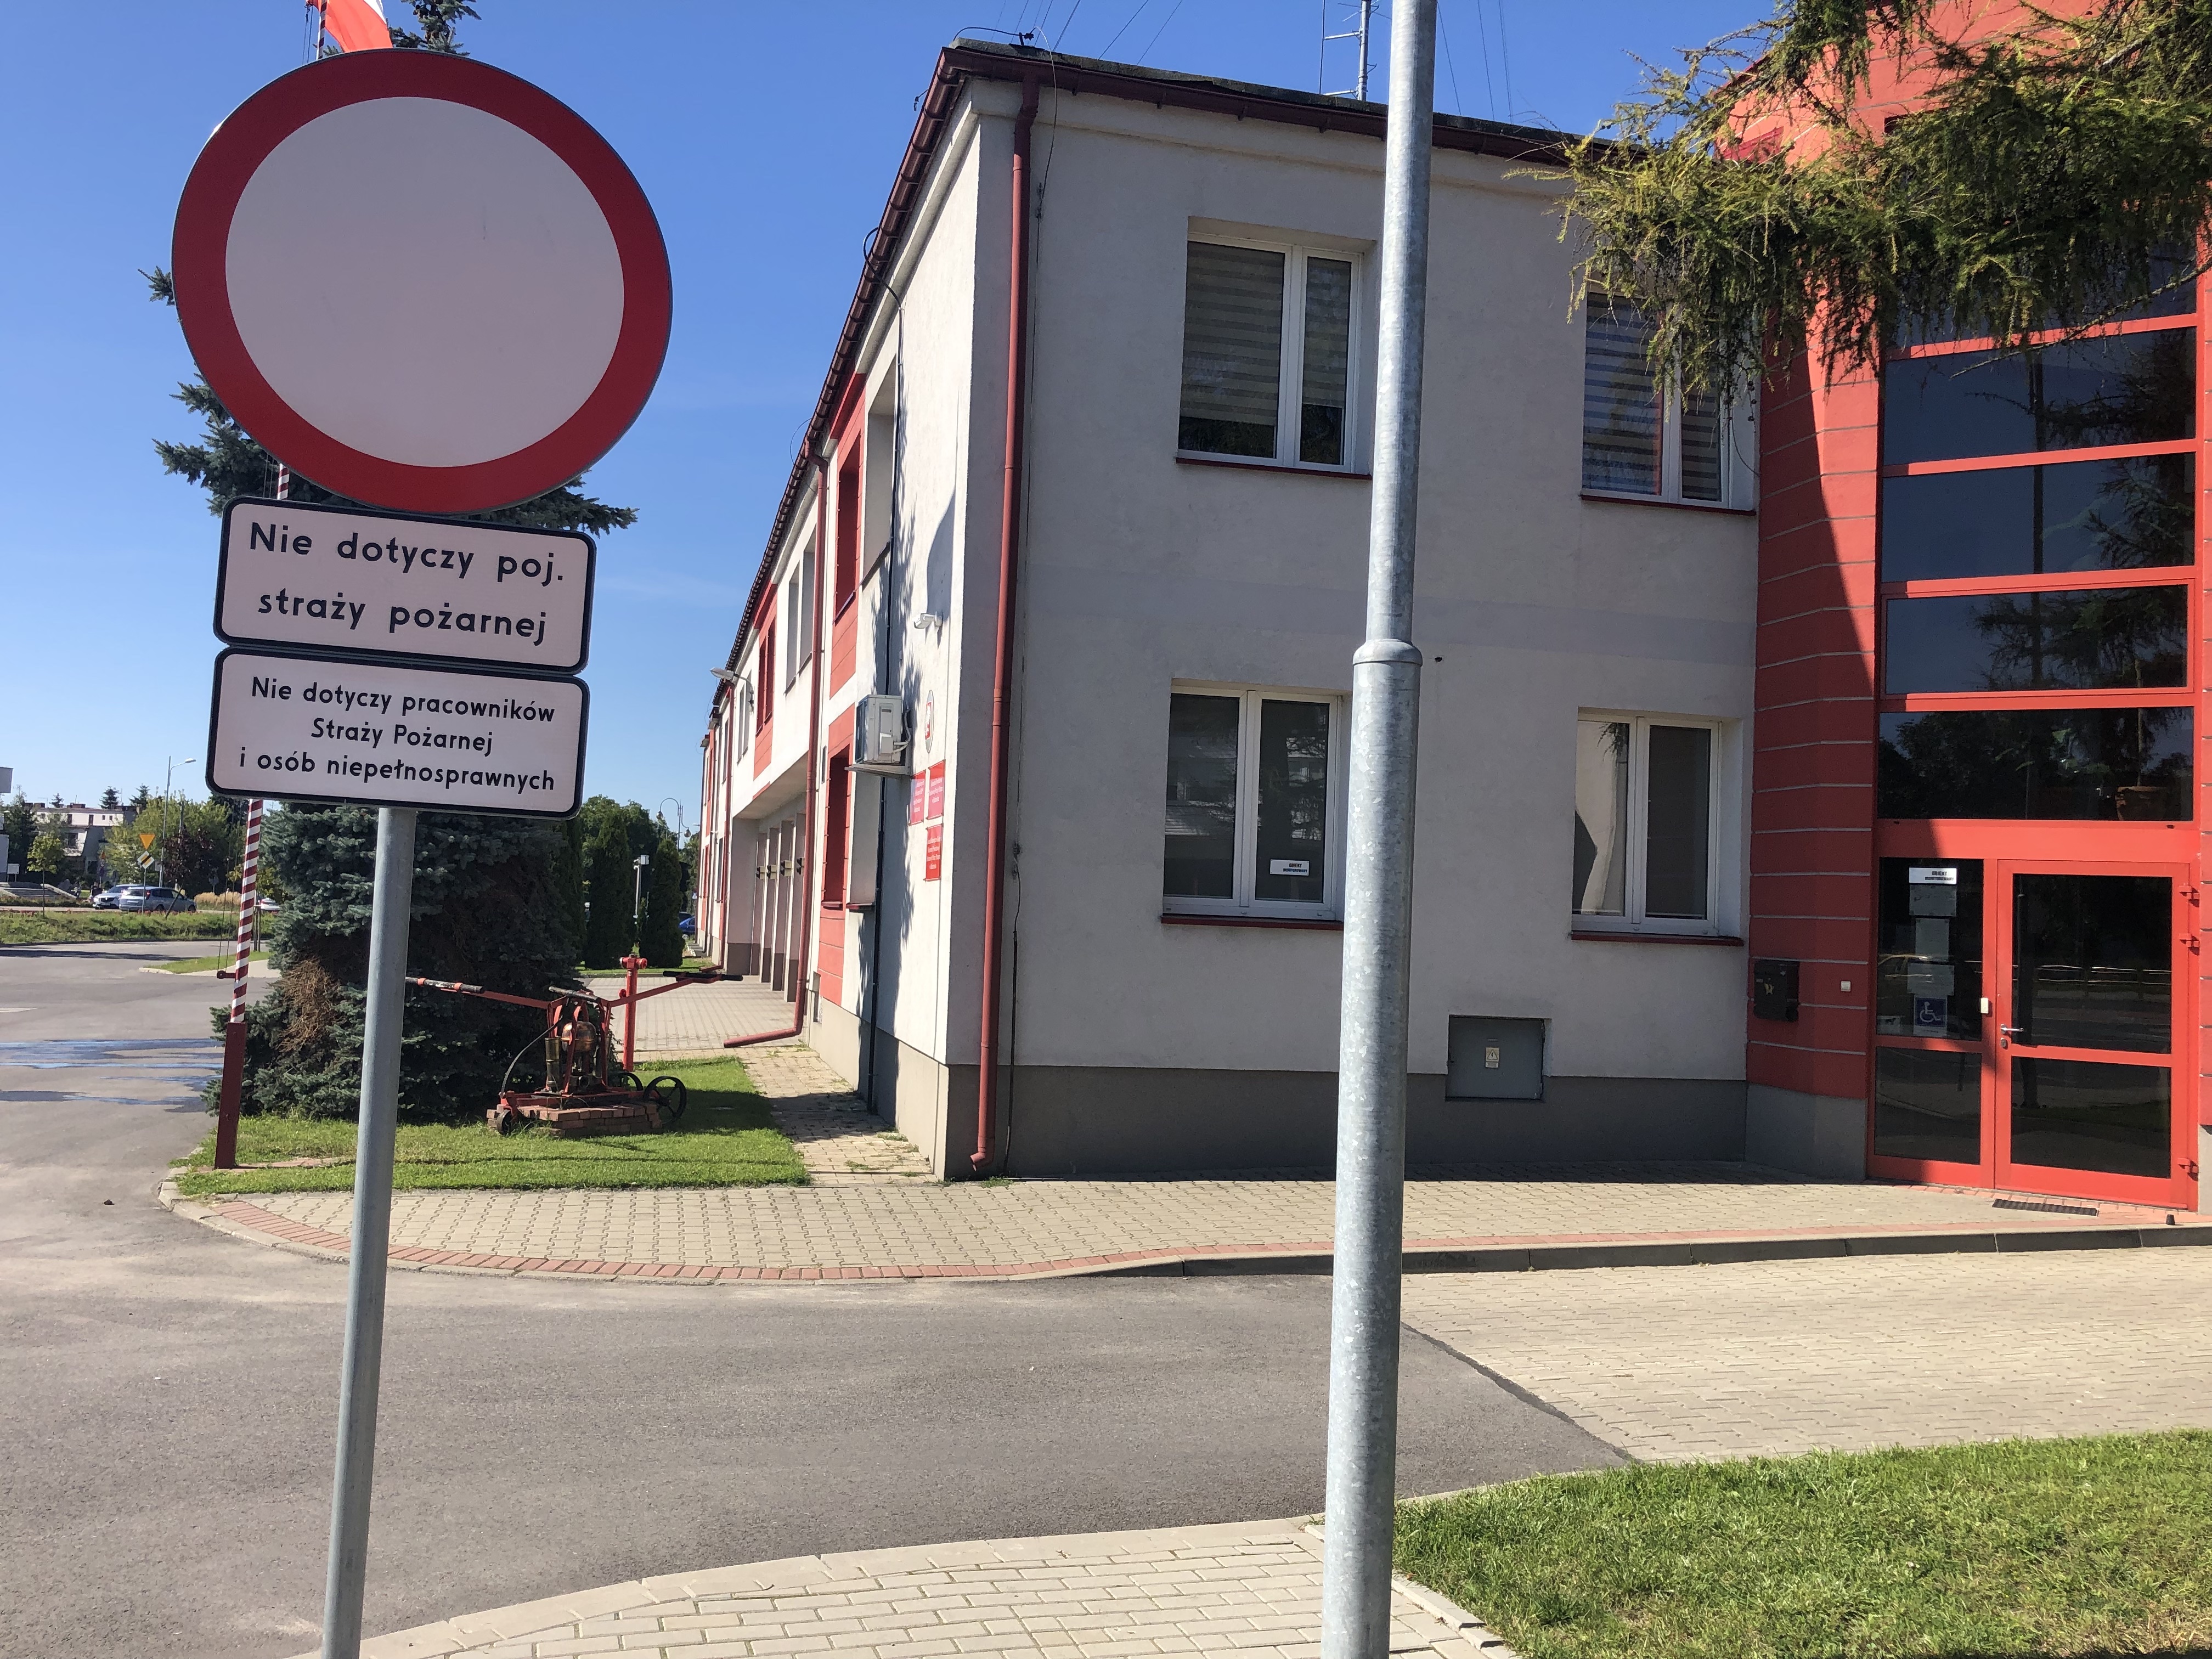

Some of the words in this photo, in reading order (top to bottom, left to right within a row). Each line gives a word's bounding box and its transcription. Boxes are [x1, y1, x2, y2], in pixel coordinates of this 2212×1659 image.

[249, 521, 313, 555] Nie
[336, 532, 475, 579] dotyczy
[496, 551, 563, 588] poj.
[257, 587, 366, 630] straży
[388, 601, 547, 647] pożarnej
[251, 676, 292, 700] Nie
[302, 681, 392, 715] dotyczy
[401, 696, 556, 723] pracowników
[310, 717, 383, 749] Straży
[393, 723, 493, 757] Pożarnej
[239, 747, 246, 768] i
[257, 749, 316, 772] osób
[326, 754, 555, 795] niepełnosprawnych
